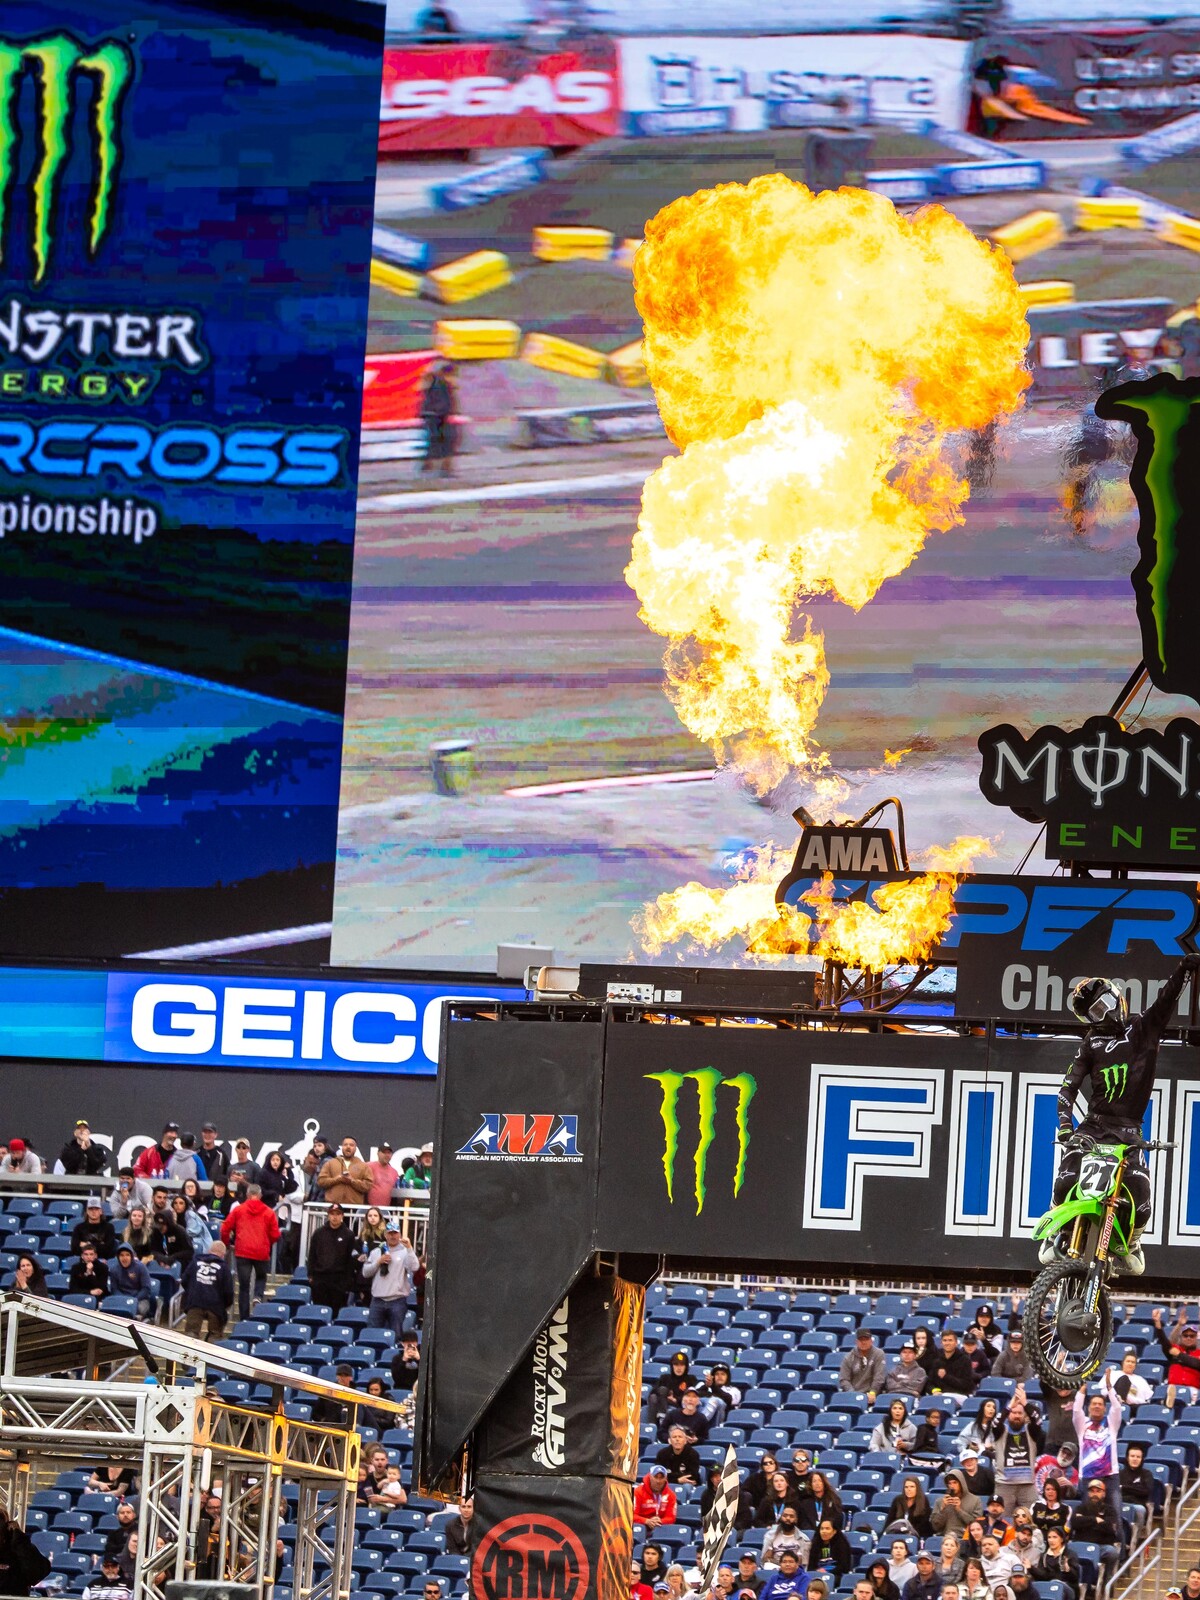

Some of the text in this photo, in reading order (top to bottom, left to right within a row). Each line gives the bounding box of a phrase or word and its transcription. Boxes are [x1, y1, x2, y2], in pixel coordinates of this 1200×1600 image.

[801, 835, 889, 872] AMA
[131, 983, 460, 1066] GEIC
[454, 1113, 584, 1156] AMA
[456, 1154, 490, 1162] AMERICAN
[490, 1155, 540, 1163] MOTORCYCLIST
[1080, 1162, 1118, 1192] 21
[1101, 1215, 1114, 1250] SHOWA
[531, 1329, 549, 1439] ROCKY MOU
[496, 1549, 569, 1599] RM
